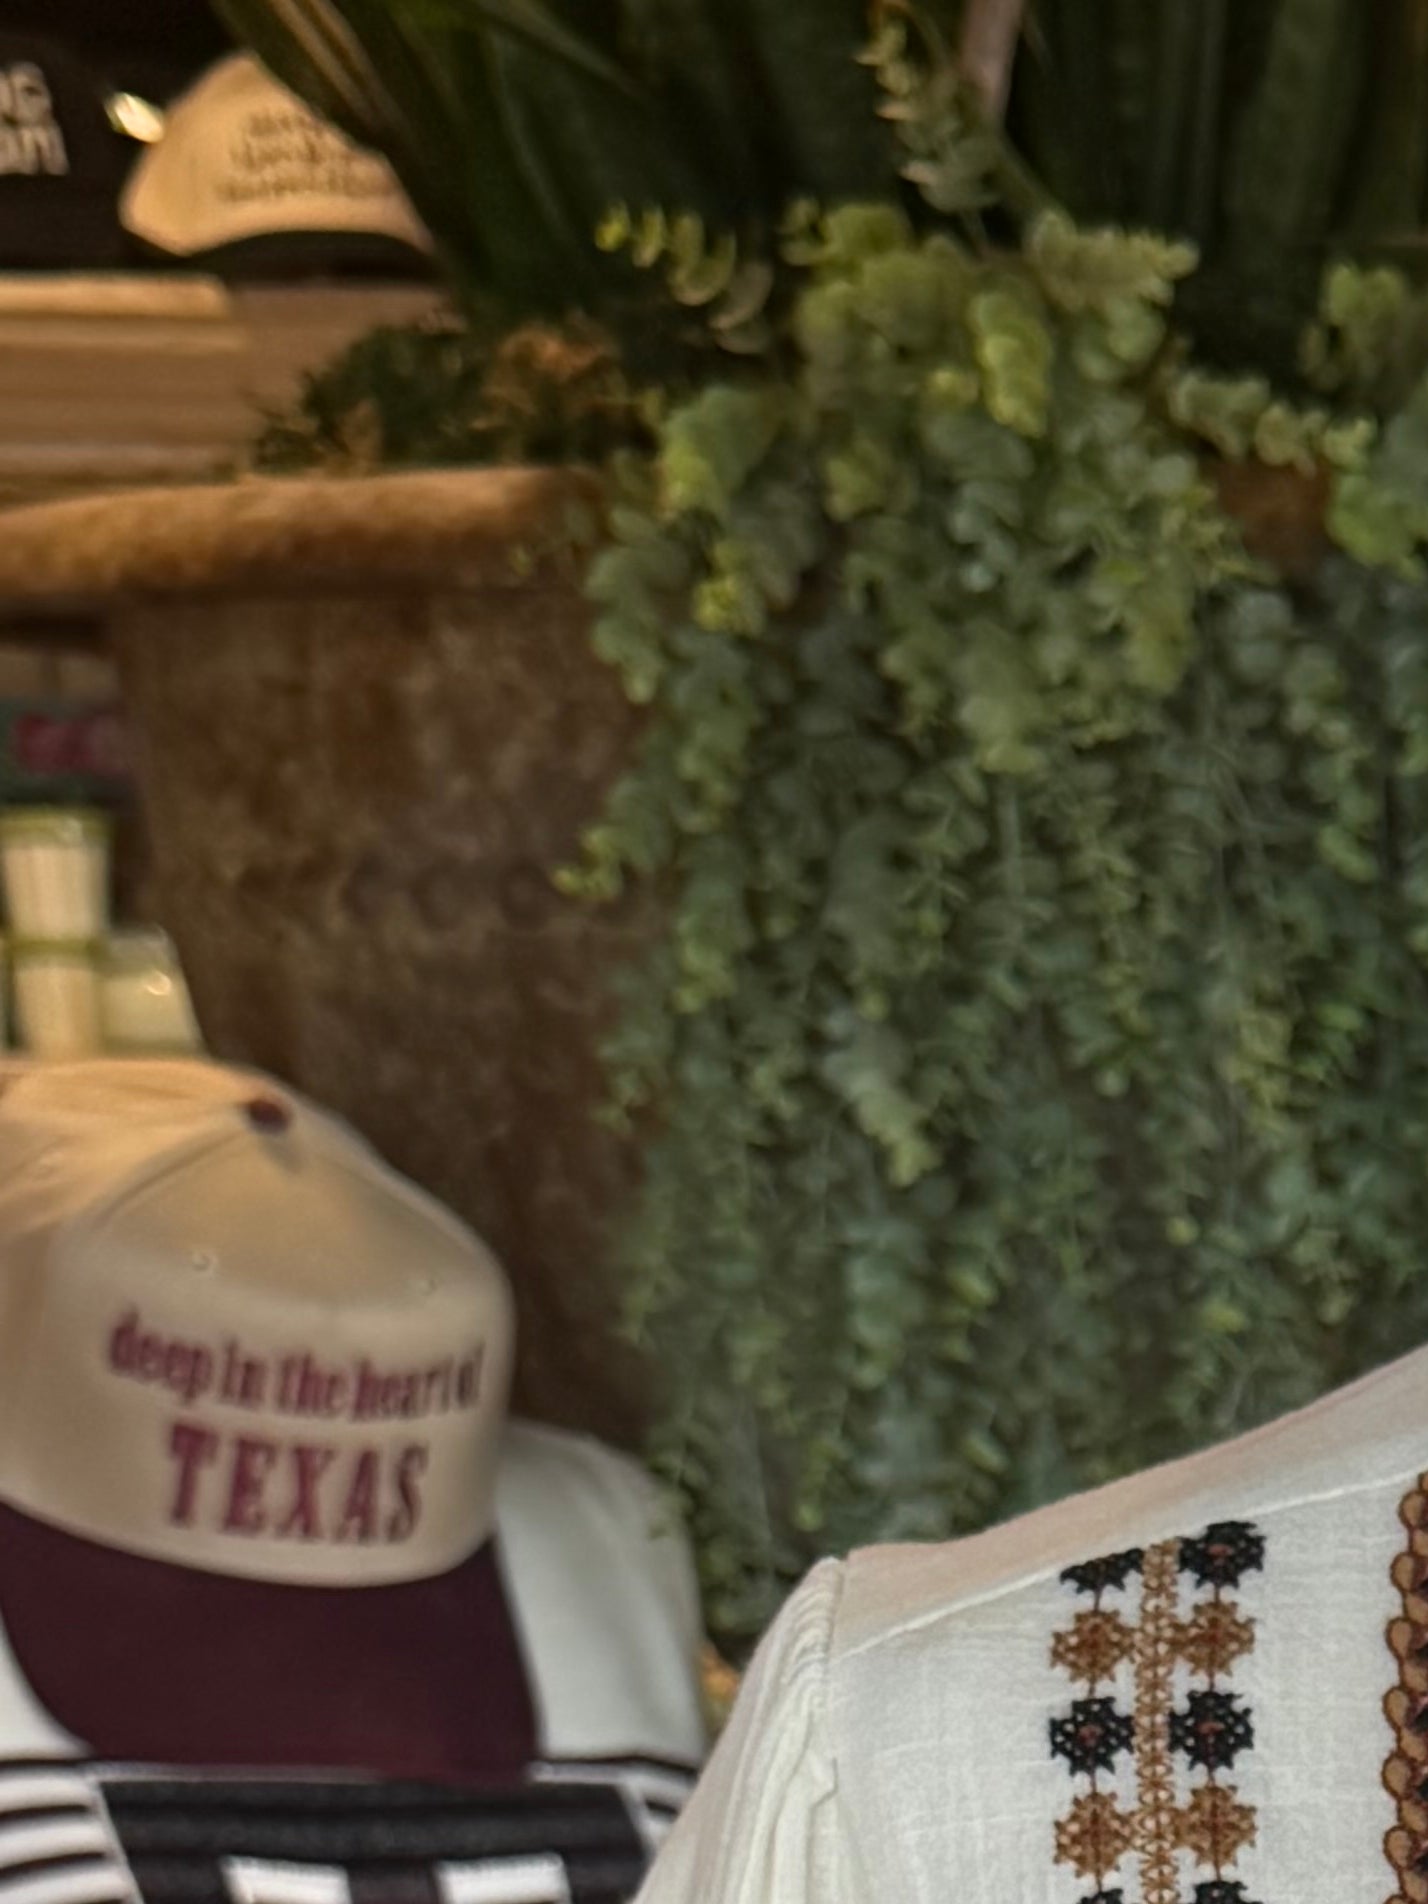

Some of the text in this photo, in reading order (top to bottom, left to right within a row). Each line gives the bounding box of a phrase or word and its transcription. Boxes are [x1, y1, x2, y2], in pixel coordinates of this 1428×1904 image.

[107, 1308, 215, 1408] deep
[219, 1338, 268, 1404] in
[275, 1346, 347, 1418] the
[166, 1418, 429, 1546] TEXAS
